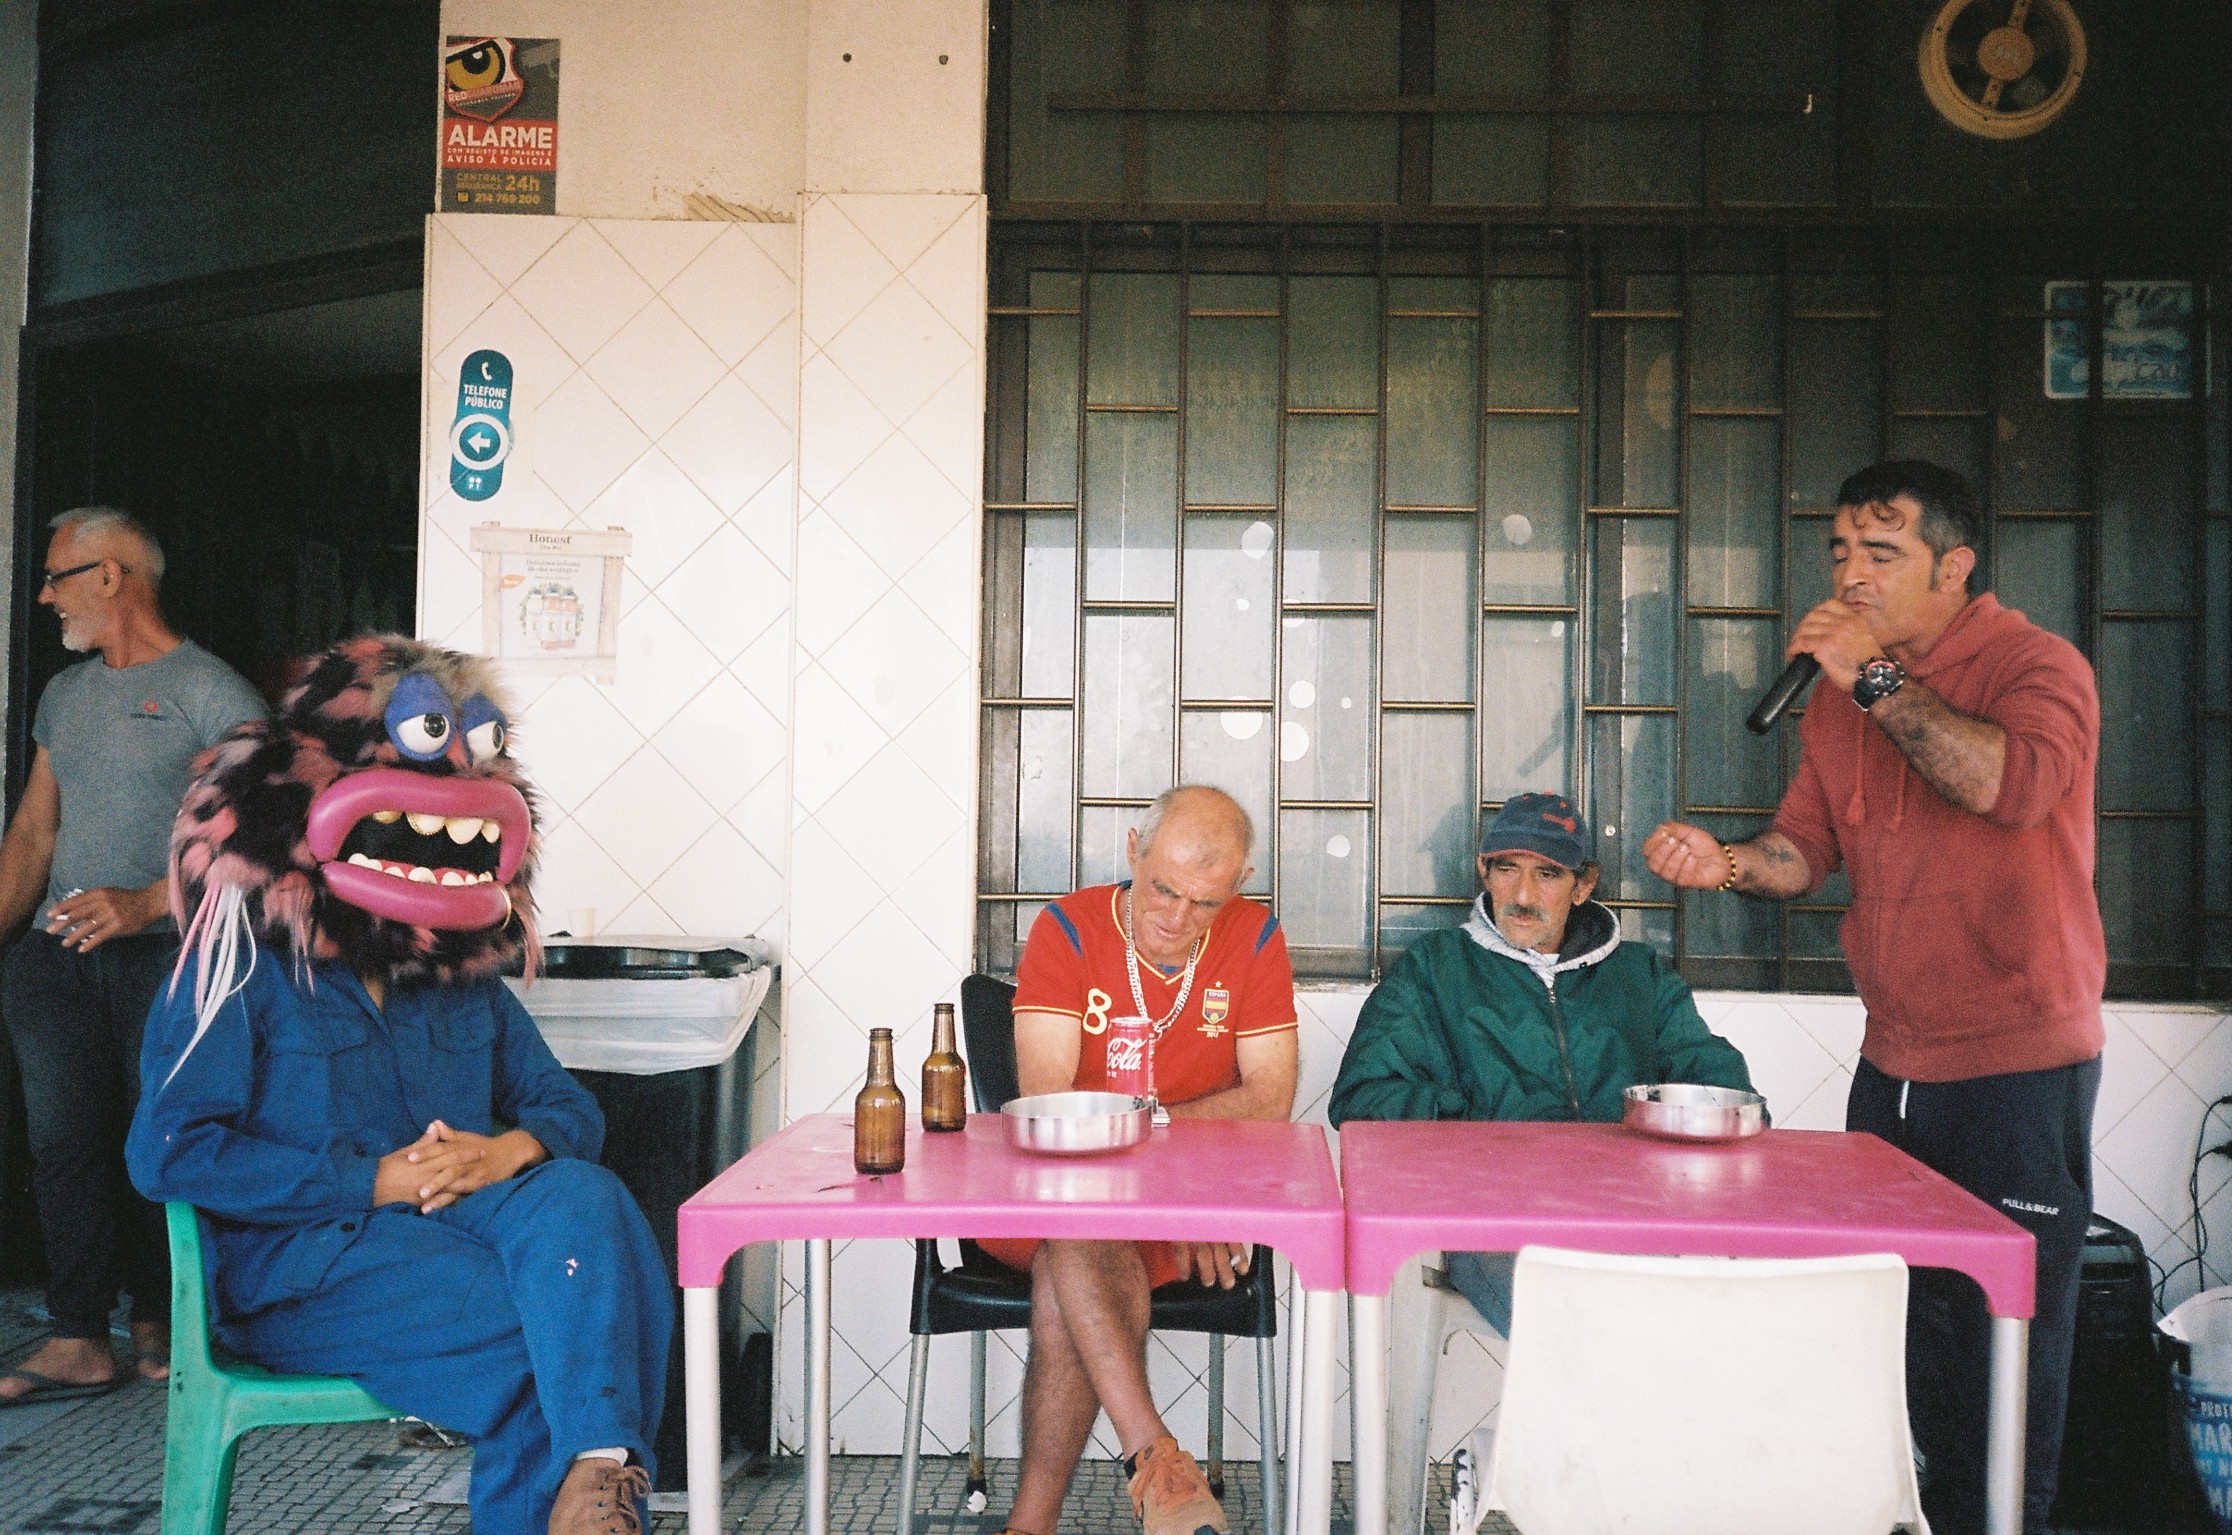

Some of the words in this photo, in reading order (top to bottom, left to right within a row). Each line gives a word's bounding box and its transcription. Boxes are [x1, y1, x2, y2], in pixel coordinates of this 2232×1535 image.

[448, 124, 553, 149] ALARME
[447, 155, 484, 164] AVISO
[505, 174, 540, 191] 24h
[463, 384, 508, 398] TELEFONE
[529, 534, 573, 544] Honest
[1083, 988, 1112, 1034] 8
[2002, 1198, 2060, 1216] PULL&BEAR
[2200, 1400, 2232, 1420] PROT
